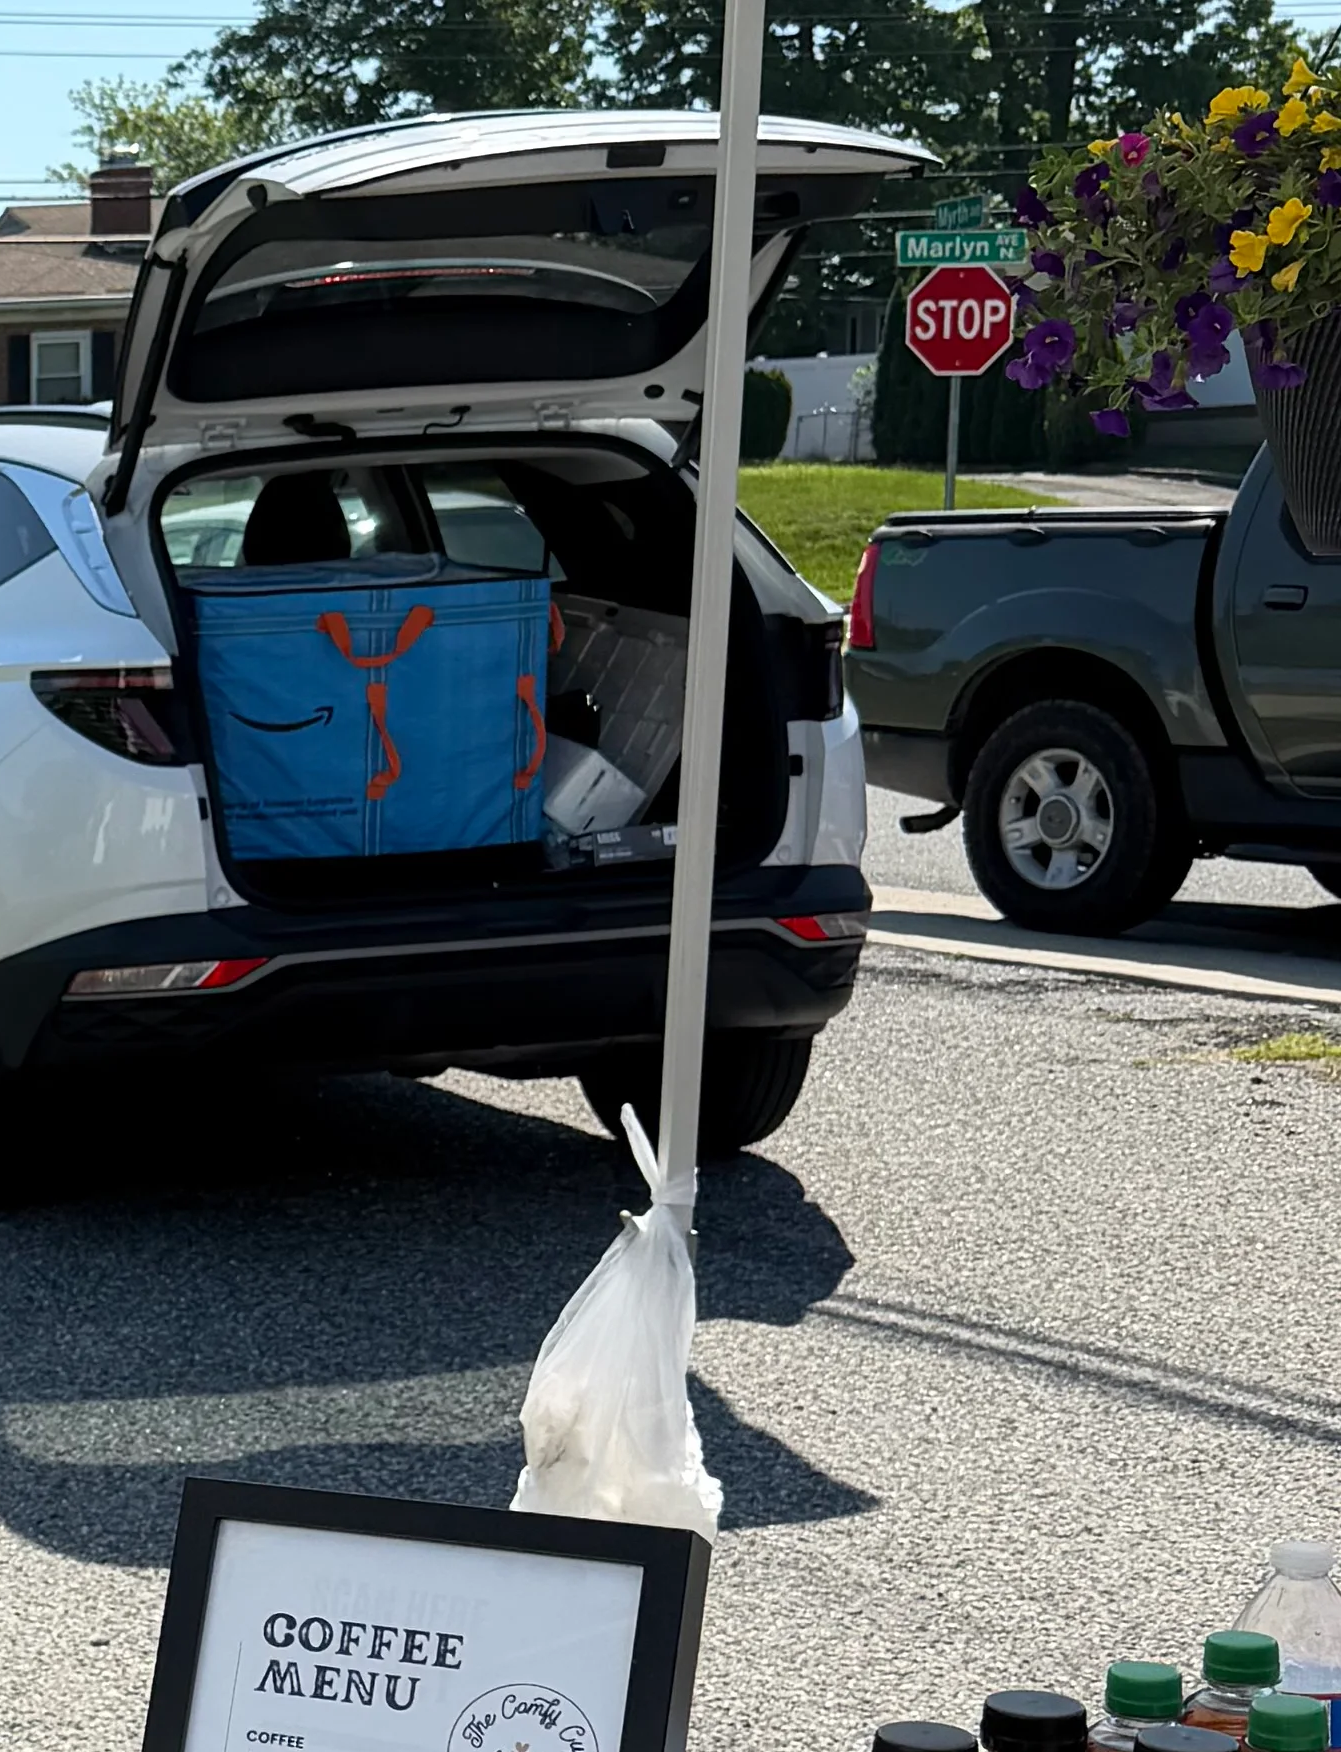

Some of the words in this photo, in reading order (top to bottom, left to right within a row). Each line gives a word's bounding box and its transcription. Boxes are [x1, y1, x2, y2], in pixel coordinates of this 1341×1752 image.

[906, 235, 990, 262] Marlyn
[995, 234, 1018, 246] AVE
[914, 298, 1006, 341] STOP
[263, 1612, 465, 1670] COFFEE
[253, 1658, 422, 1711] MENU
[245, 1729, 305, 1750] COFFEE
[461, 1712, 497, 1749] The
[501, 1693, 562, 1730] Comfy
